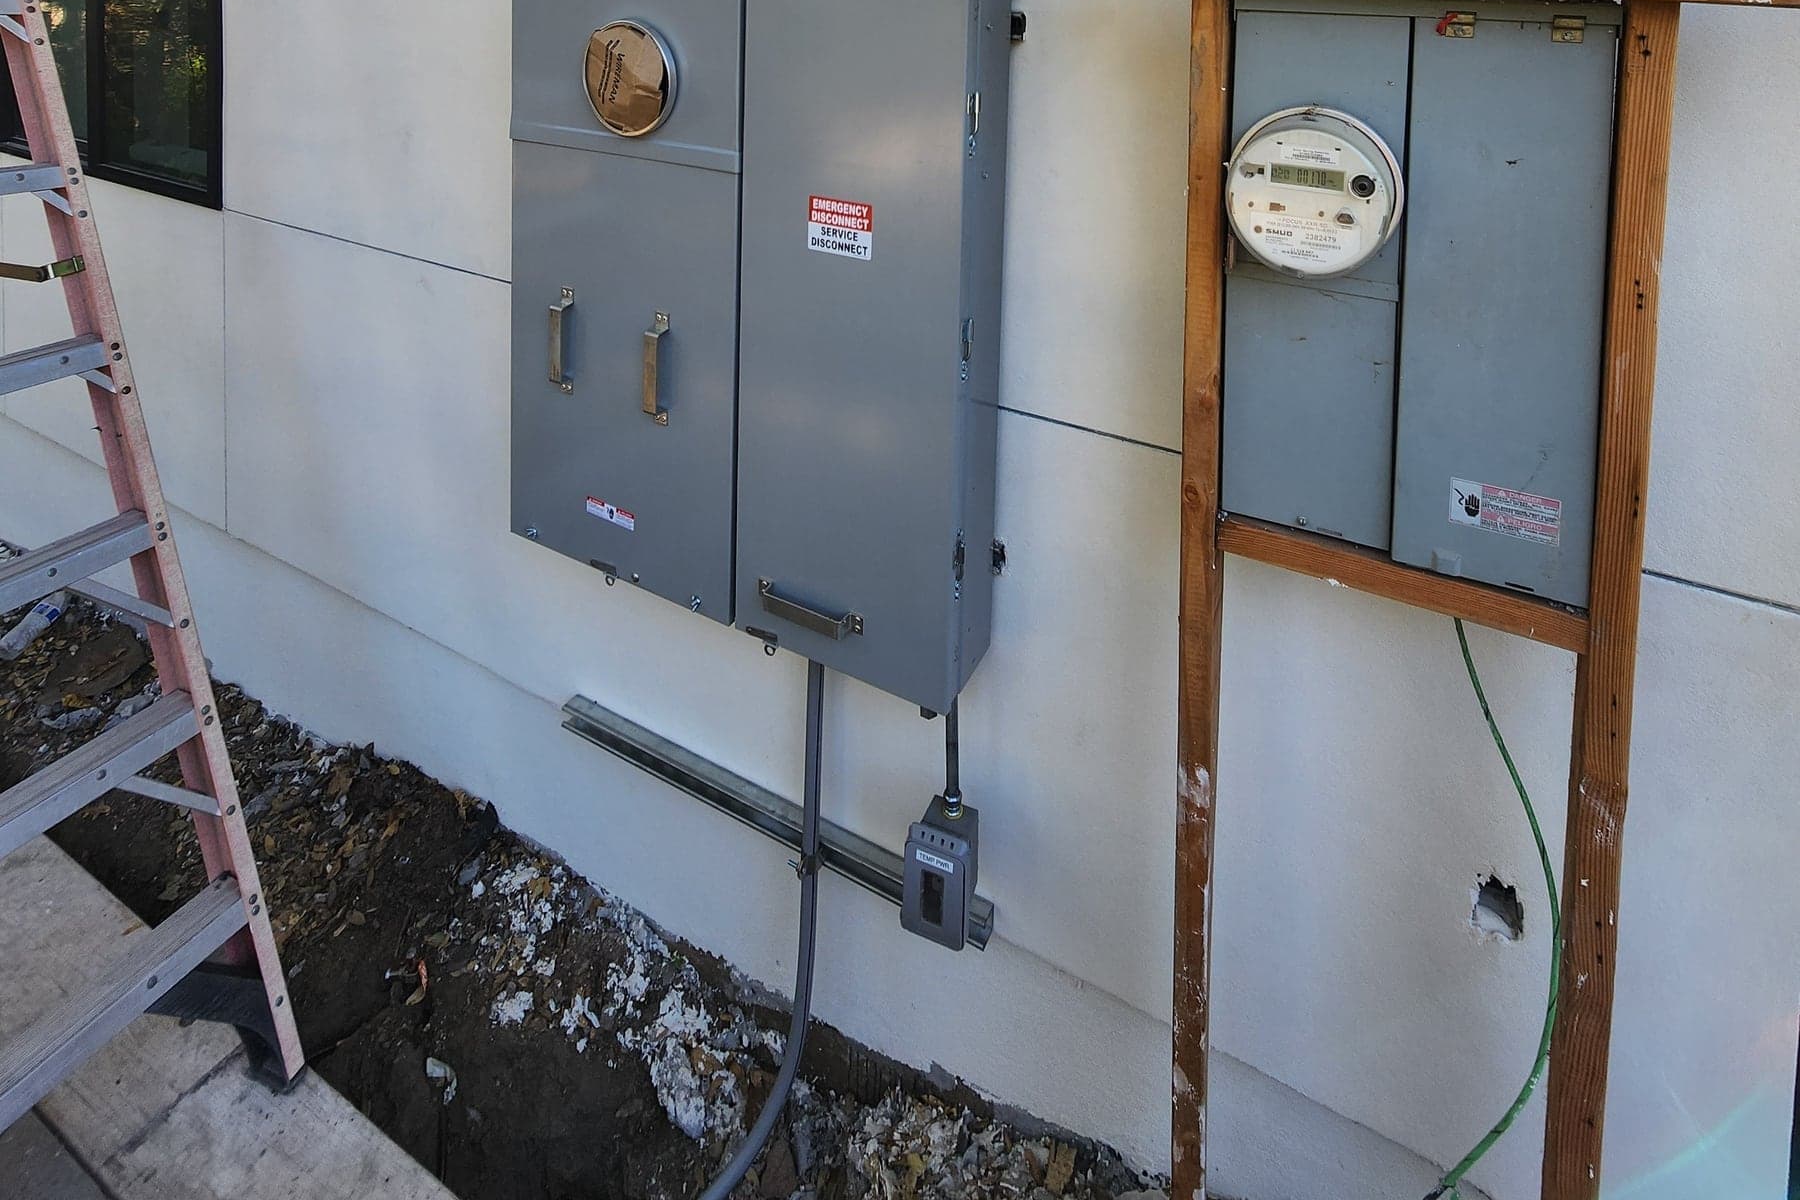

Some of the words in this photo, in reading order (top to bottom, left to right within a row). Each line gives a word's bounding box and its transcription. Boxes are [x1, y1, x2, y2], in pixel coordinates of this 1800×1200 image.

[608, 52, 625, 104] WIREMAN
[812, 198, 868, 217] EMERGENCY
[811, 210, 869, 230] DISCONNECT
[820, 226, 858, 242] SERVICE
[1265, 228, 1293, 237] SMUD
[811, 237, 868, 256] DISCONNECT
[1509, 490, 1542, 504] DANGER
[1507, 517, 1543, 531] PELIGRO
